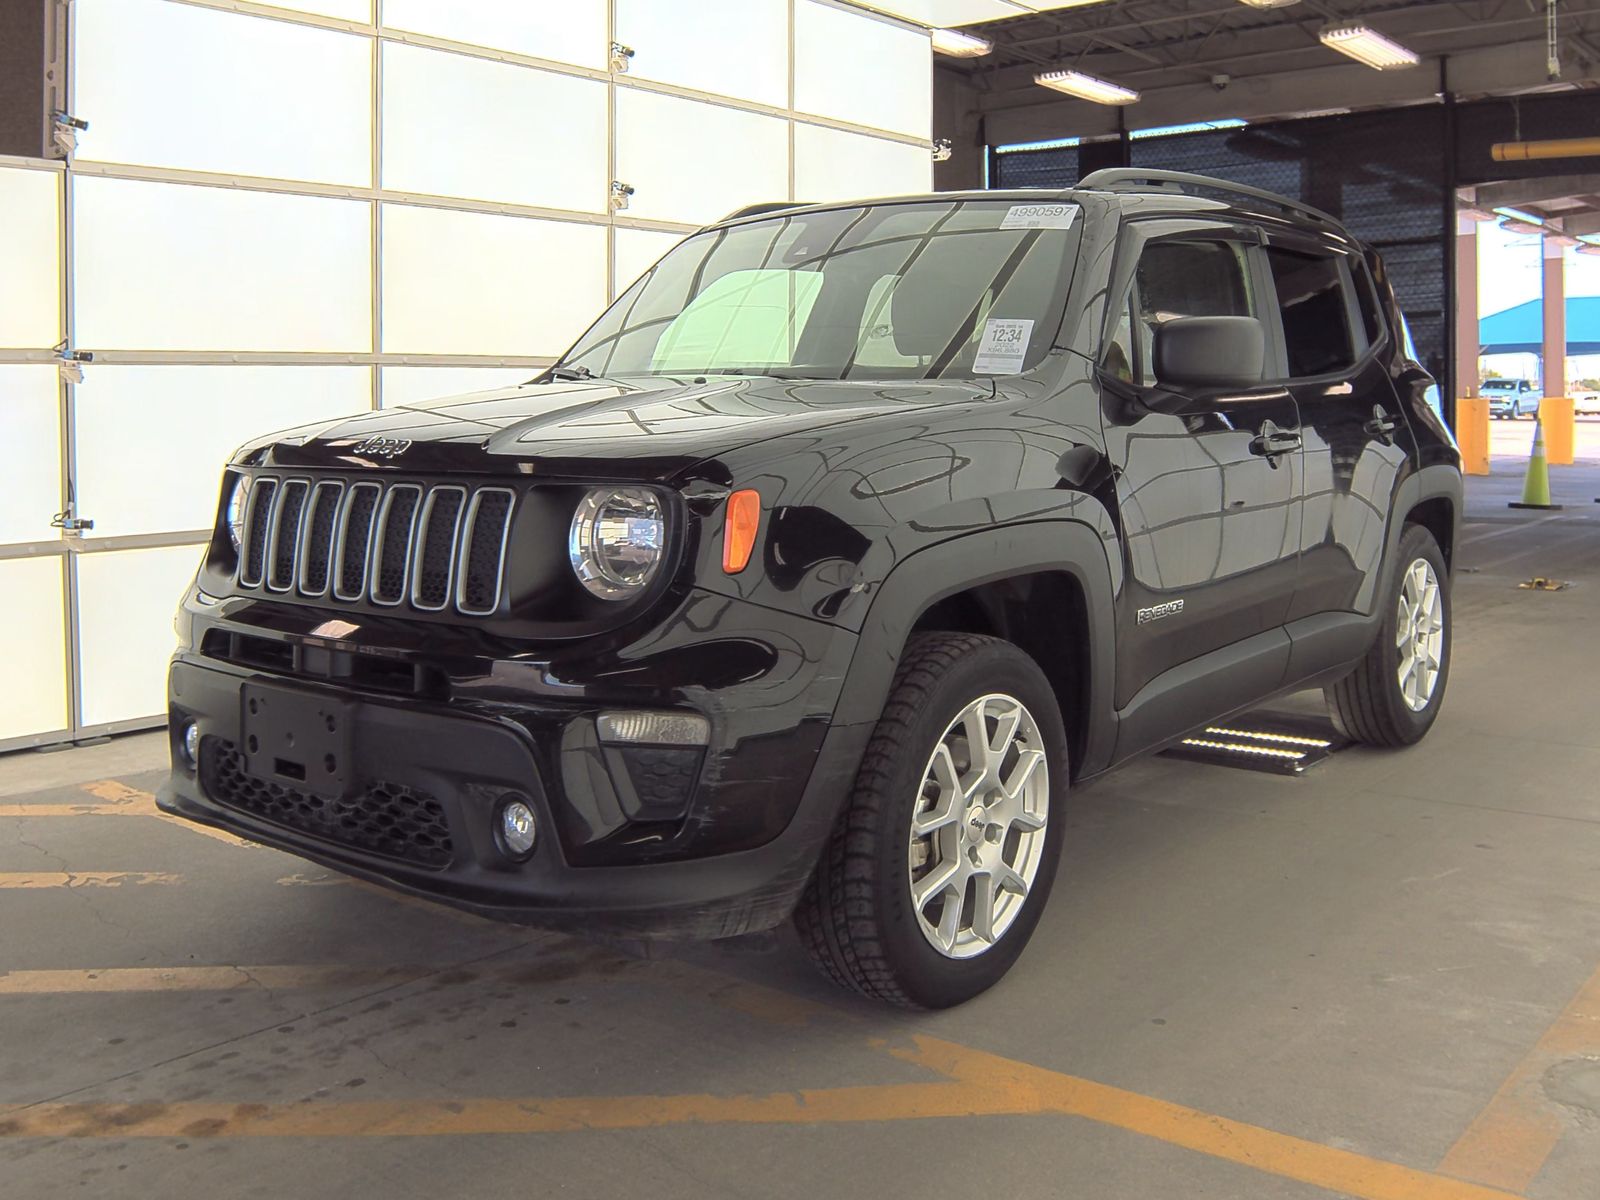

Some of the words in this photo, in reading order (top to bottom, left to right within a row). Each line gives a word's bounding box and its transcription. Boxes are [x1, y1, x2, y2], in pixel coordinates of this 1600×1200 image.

[1010, 206, 1074, 217] 4990597
[992, 328, 1023, 342] 12:34
[353, 434, 413, 459] Jeep
[1137, 598, 1184, 625] RENEGADE
